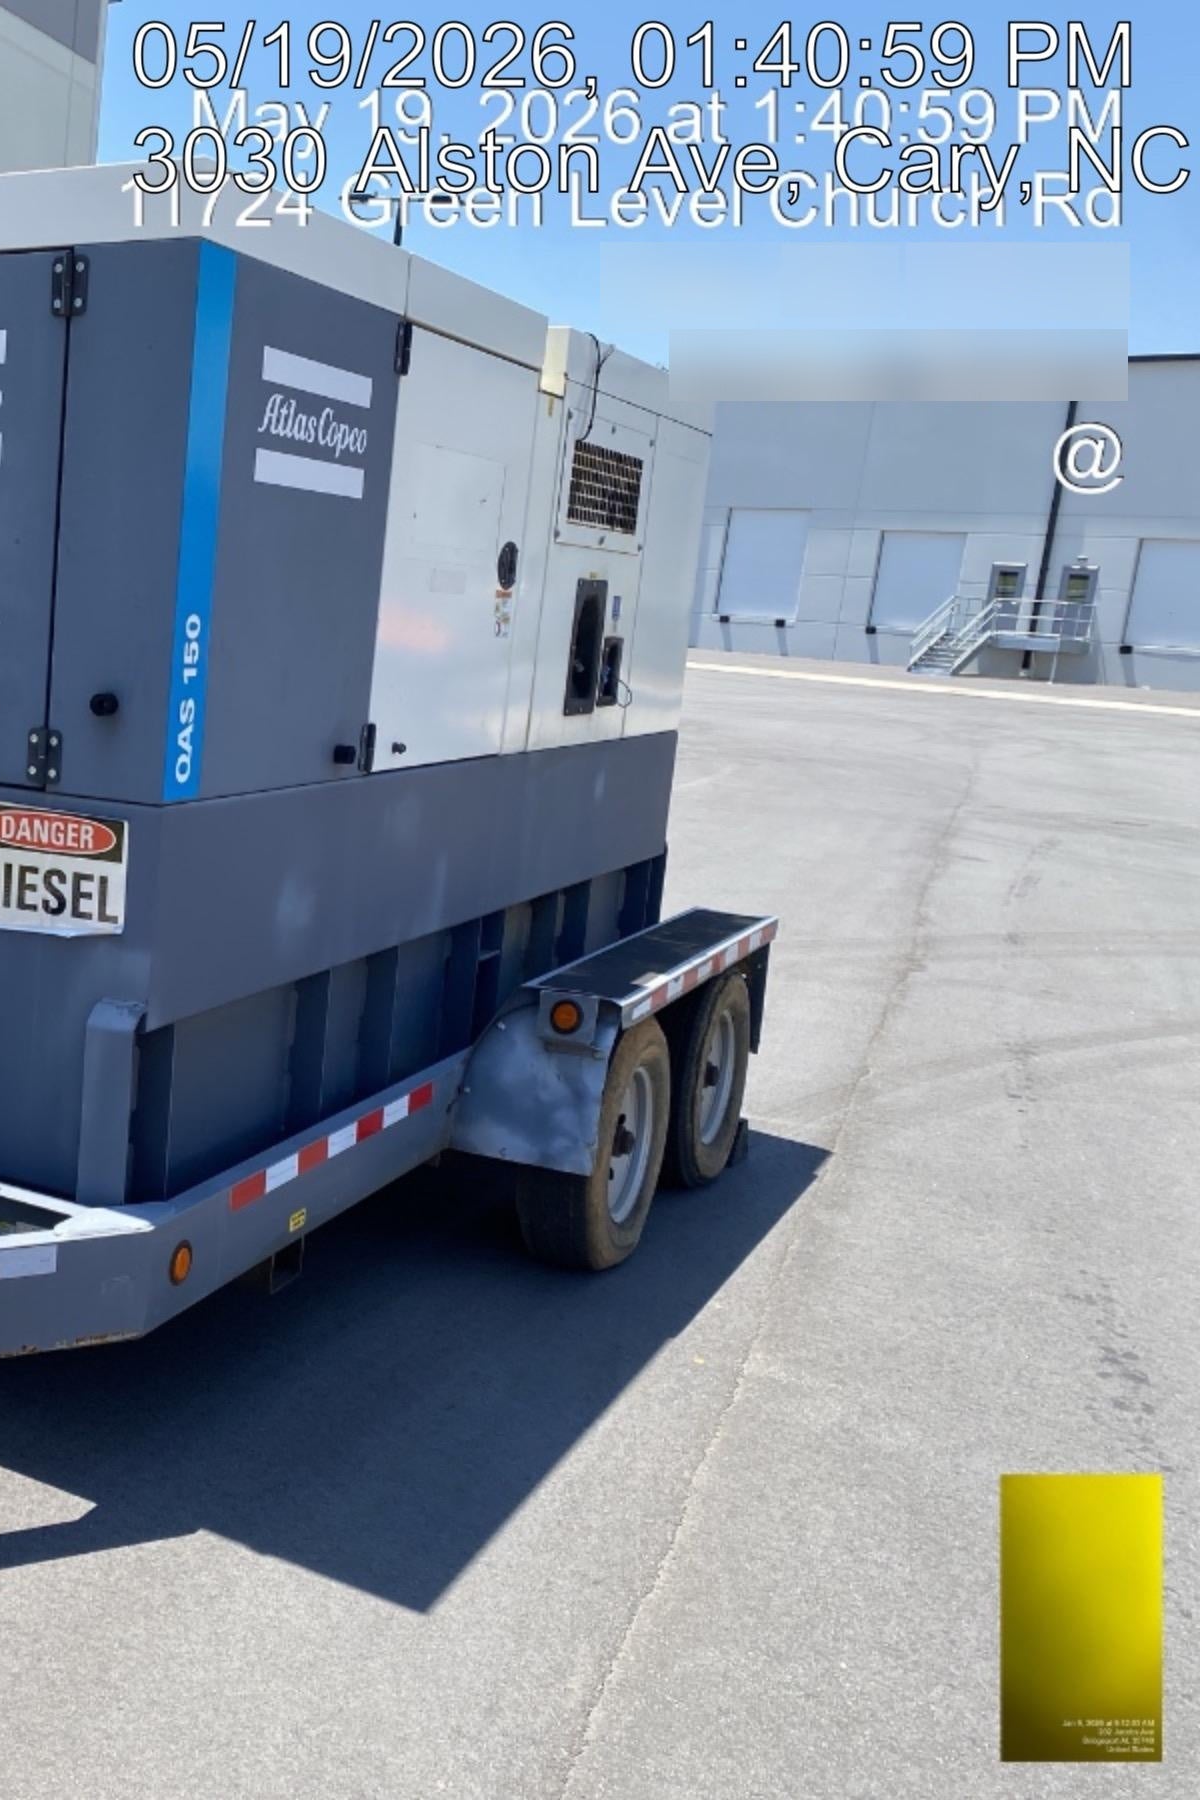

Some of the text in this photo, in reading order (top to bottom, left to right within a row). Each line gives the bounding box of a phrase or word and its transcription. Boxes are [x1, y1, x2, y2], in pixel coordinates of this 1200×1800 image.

[257, 393, 367, 456] Atlas Copco
[183, 614, 201, 683] 150
[1, 816, 95, 849] DANGER
